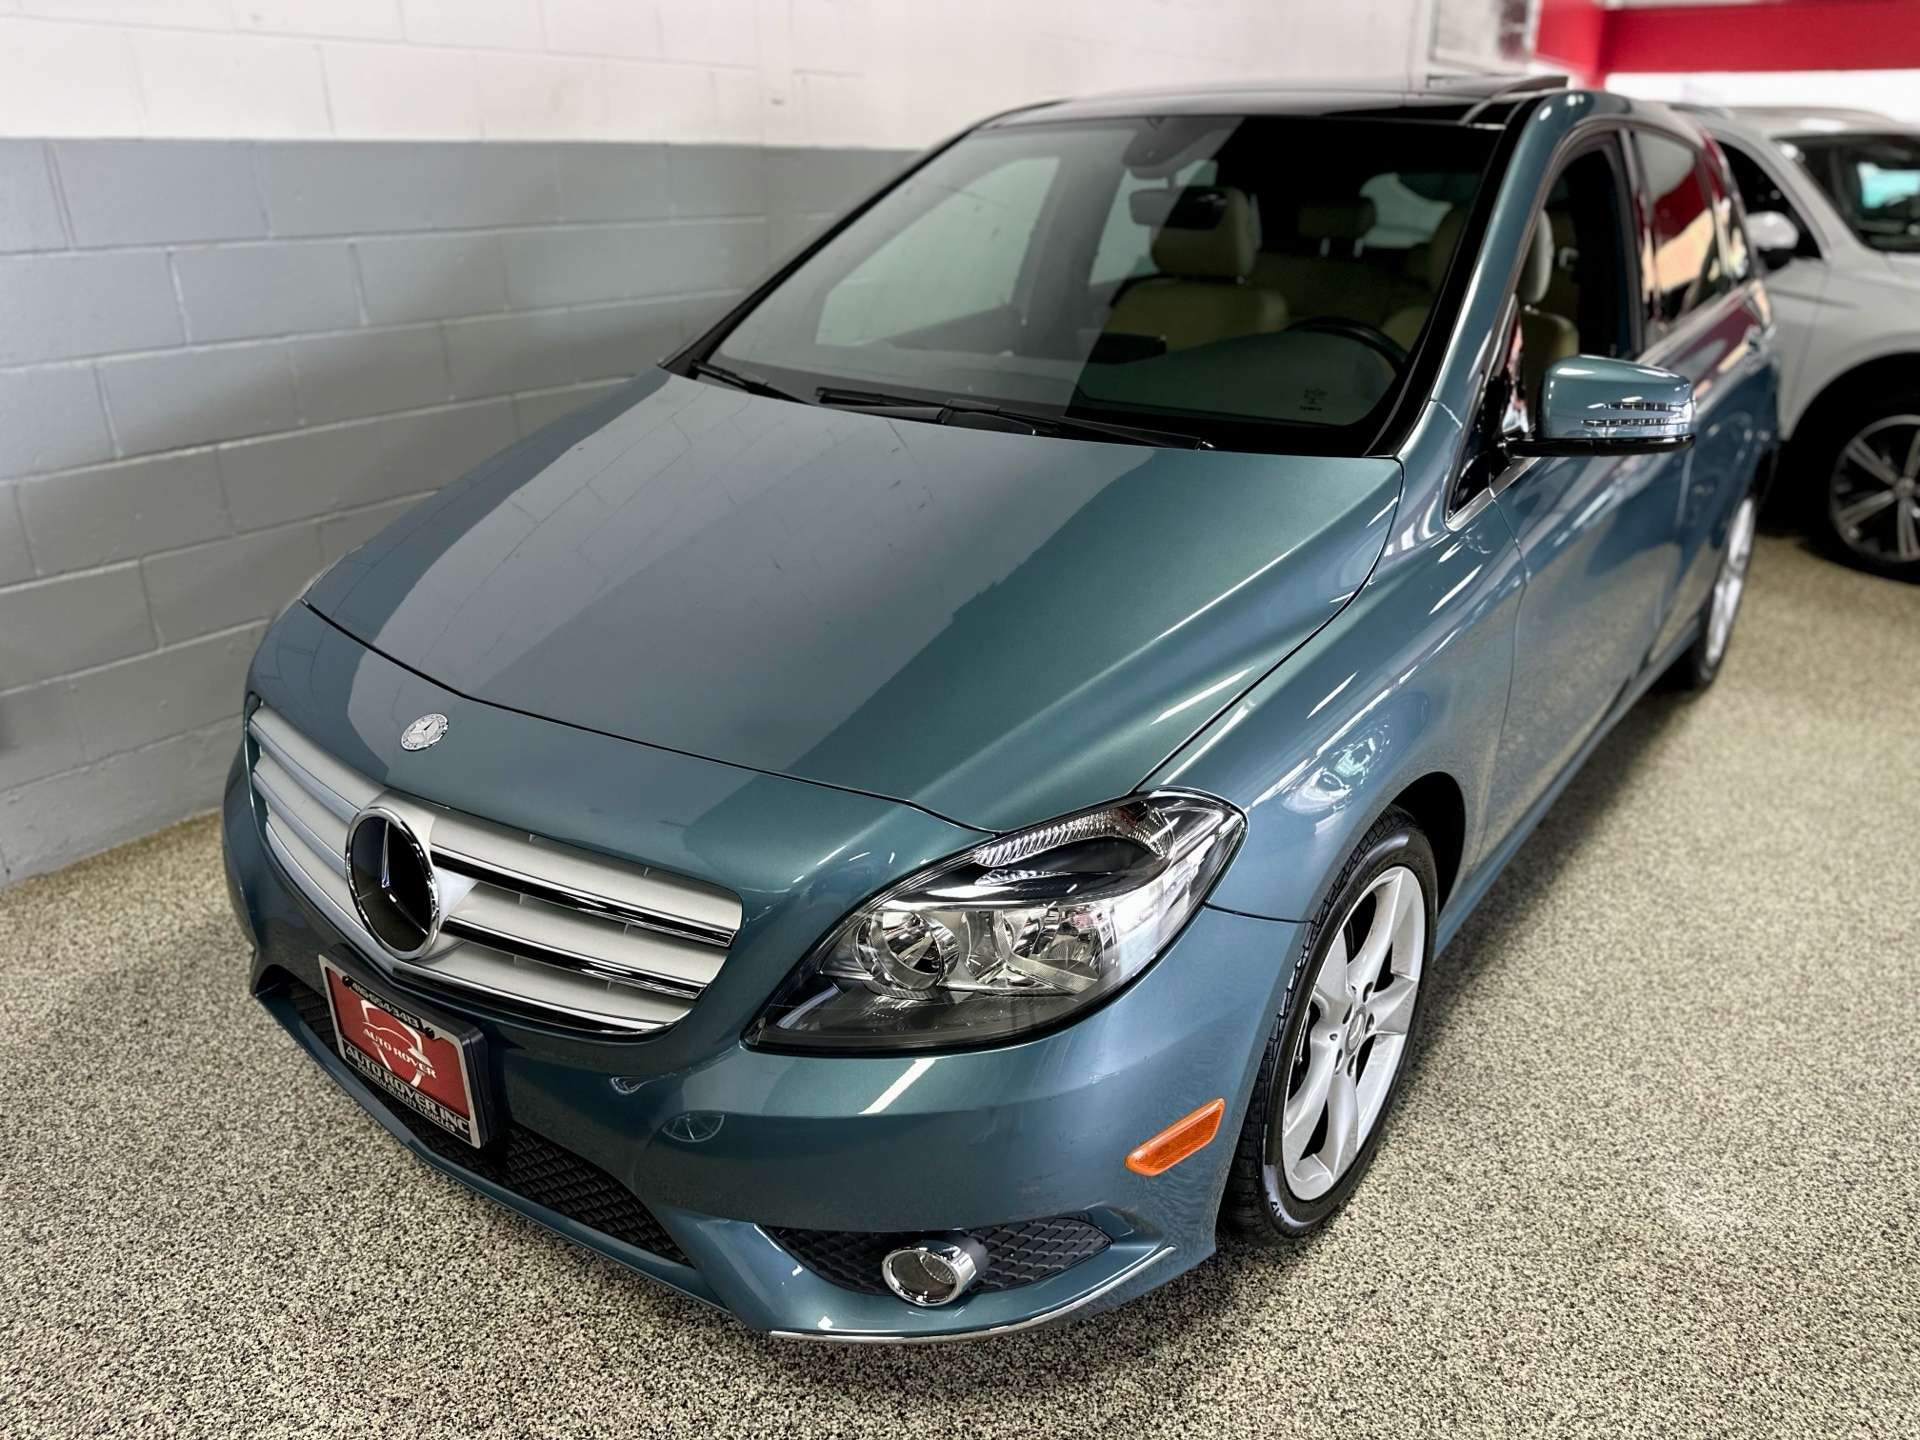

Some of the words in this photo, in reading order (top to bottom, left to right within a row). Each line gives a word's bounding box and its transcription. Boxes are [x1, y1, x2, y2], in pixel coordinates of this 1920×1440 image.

[362, 1028, 392, 1051] AUTO
[393, 1047, 437, 1079] ROVER
[345, 1046, 381, 1078] AUTO
[383, 1070, 439, 1115] ROVER
[440, 1105, 469, 1134] INC
